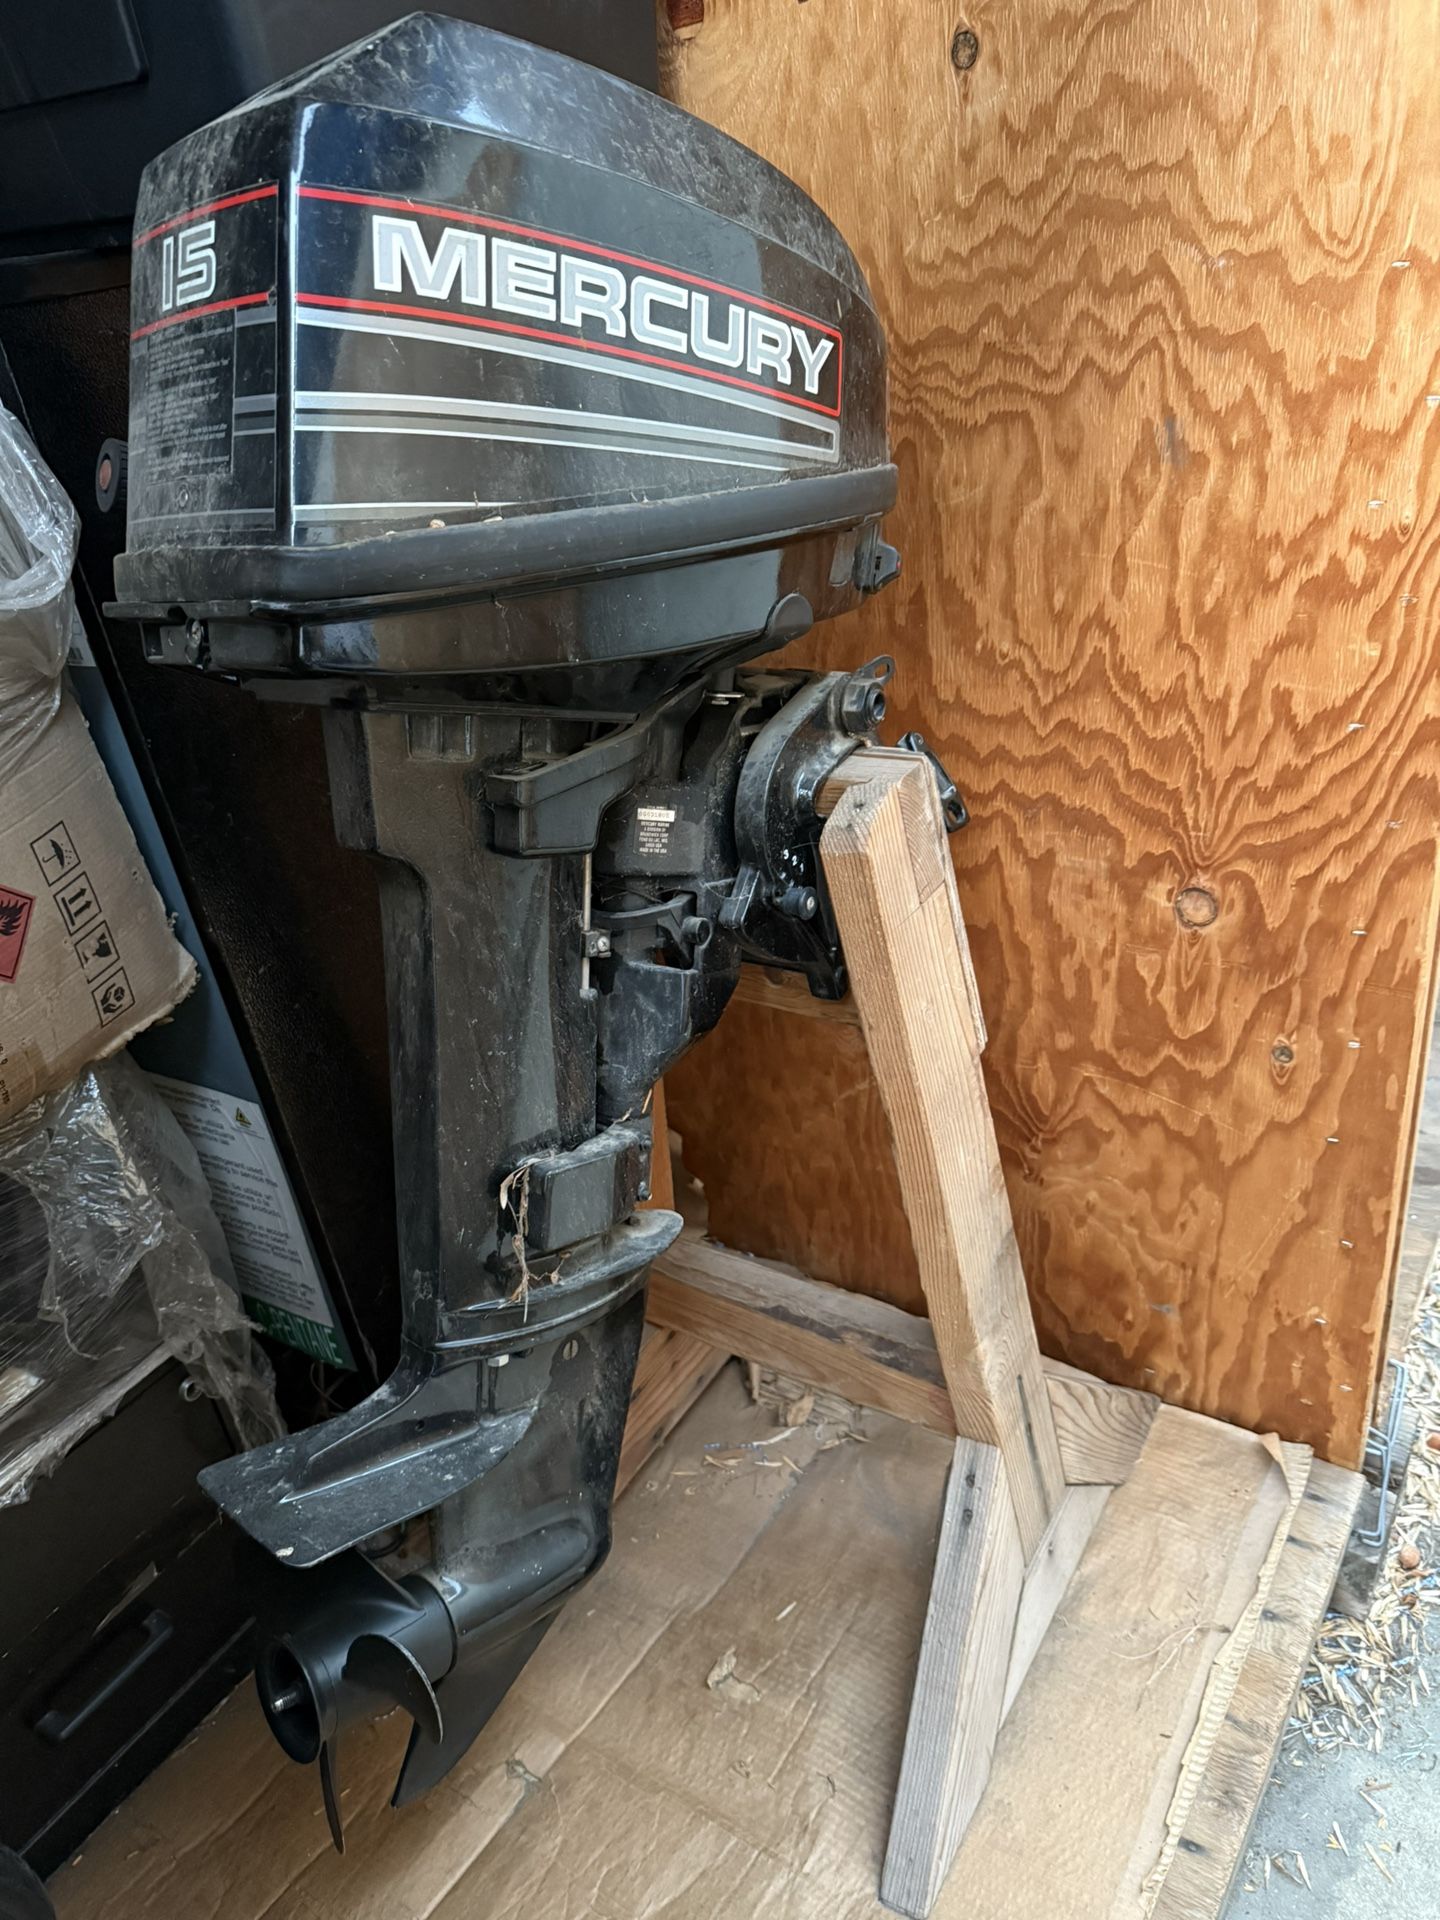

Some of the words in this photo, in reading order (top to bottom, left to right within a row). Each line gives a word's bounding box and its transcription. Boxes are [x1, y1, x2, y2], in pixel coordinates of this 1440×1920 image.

[162, 220, 216, 312] 15
[372, 214, 834, 395] MERCURY
[792, 855, 798, 866] 2
